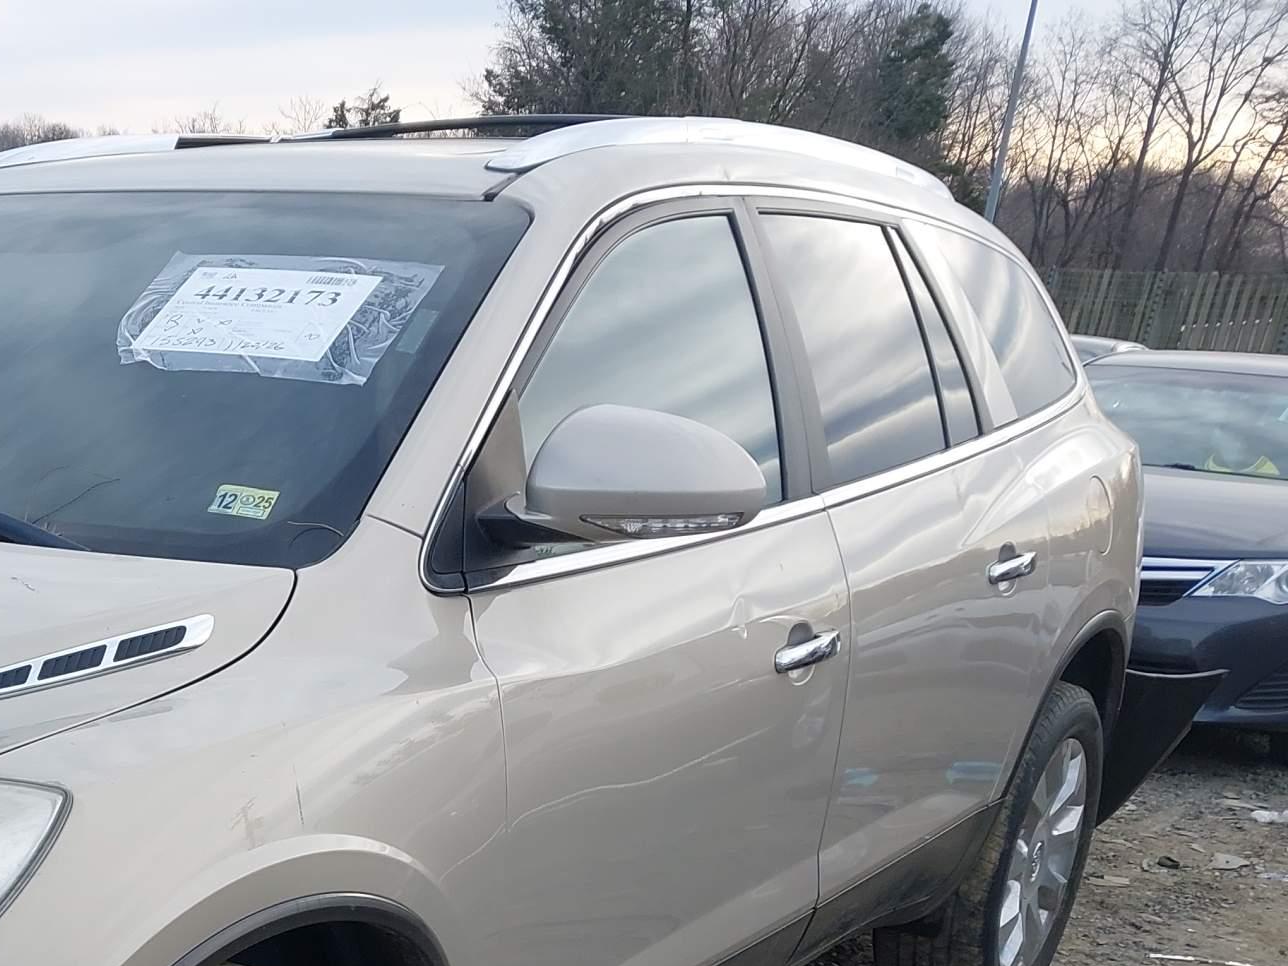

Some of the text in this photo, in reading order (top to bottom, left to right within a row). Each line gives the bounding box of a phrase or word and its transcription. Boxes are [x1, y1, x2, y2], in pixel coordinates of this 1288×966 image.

[193, 284, 343, 307] 44132173
[217, 491, 274, 509] 12 25
